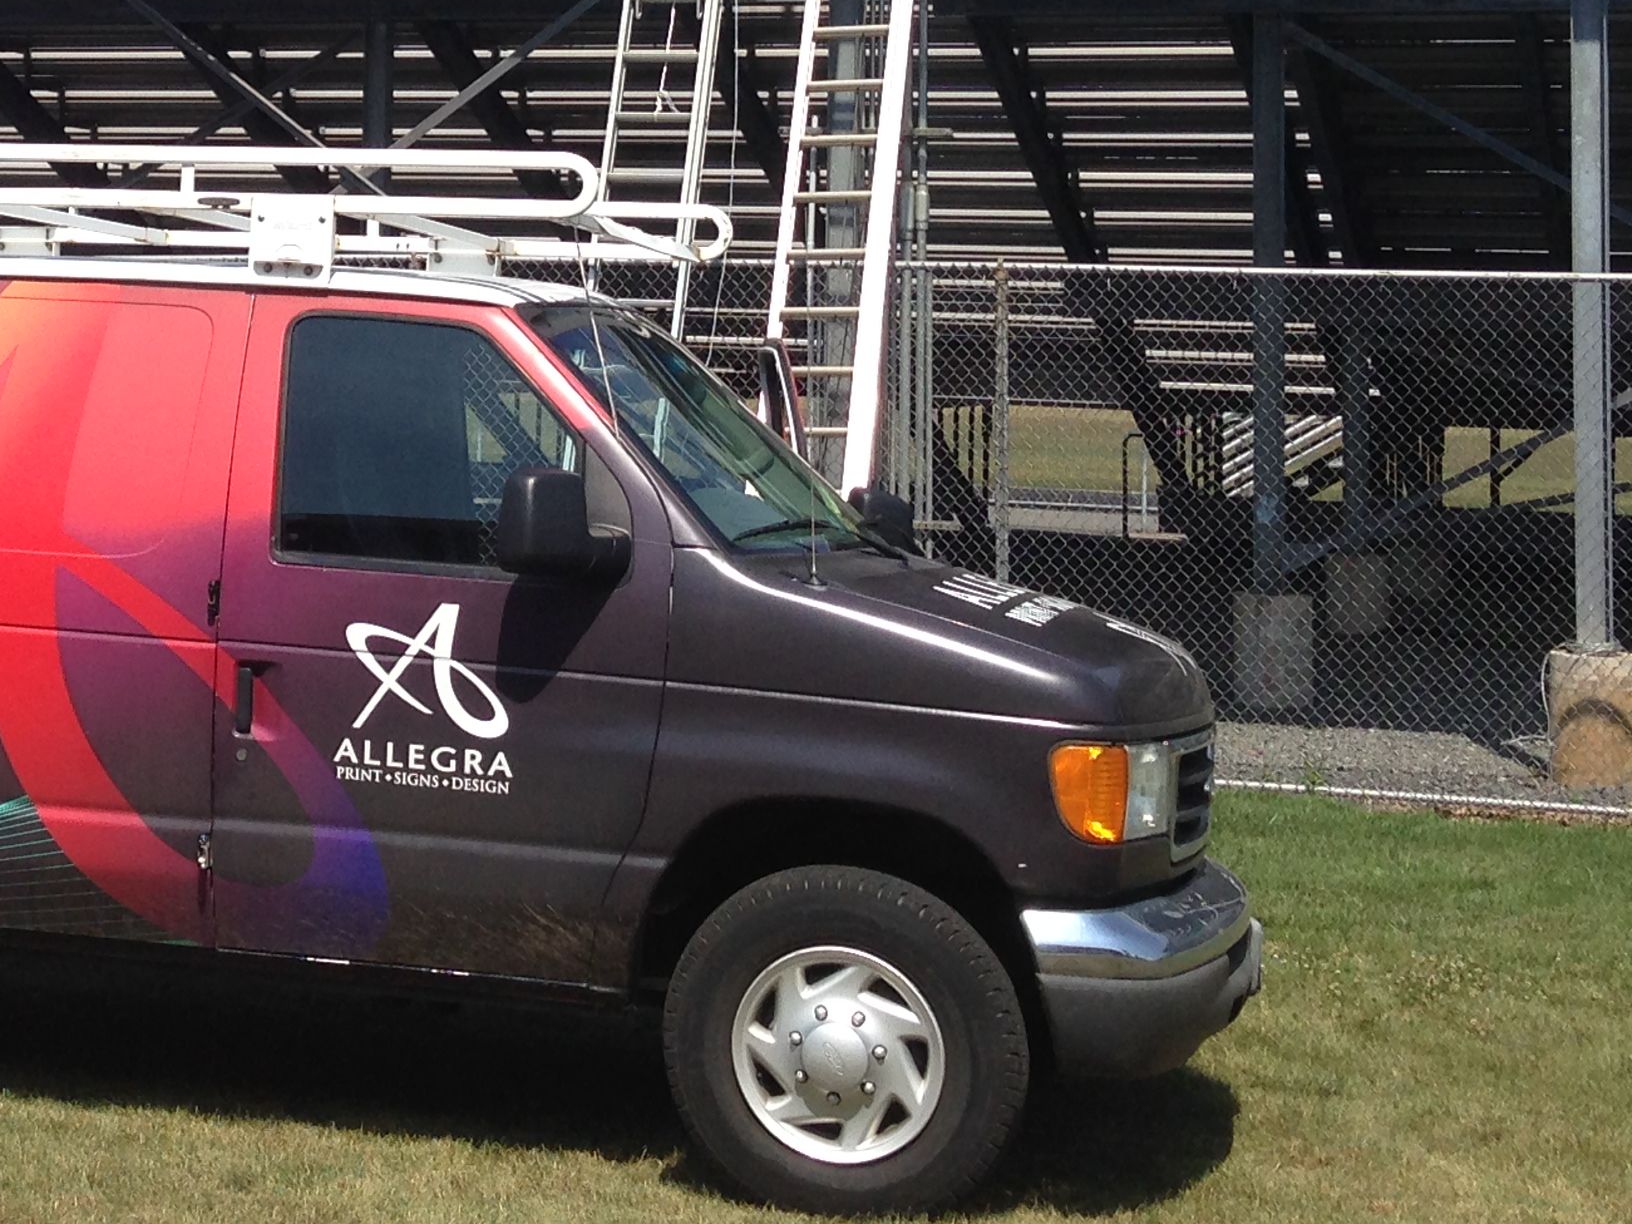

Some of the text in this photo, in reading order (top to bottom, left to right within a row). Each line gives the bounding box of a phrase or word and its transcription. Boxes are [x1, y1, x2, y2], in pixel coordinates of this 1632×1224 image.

[333, 738, 513, 778] ALLEGRA
[336, 766, 509, 794] PRINT SIGNS DESIGN
